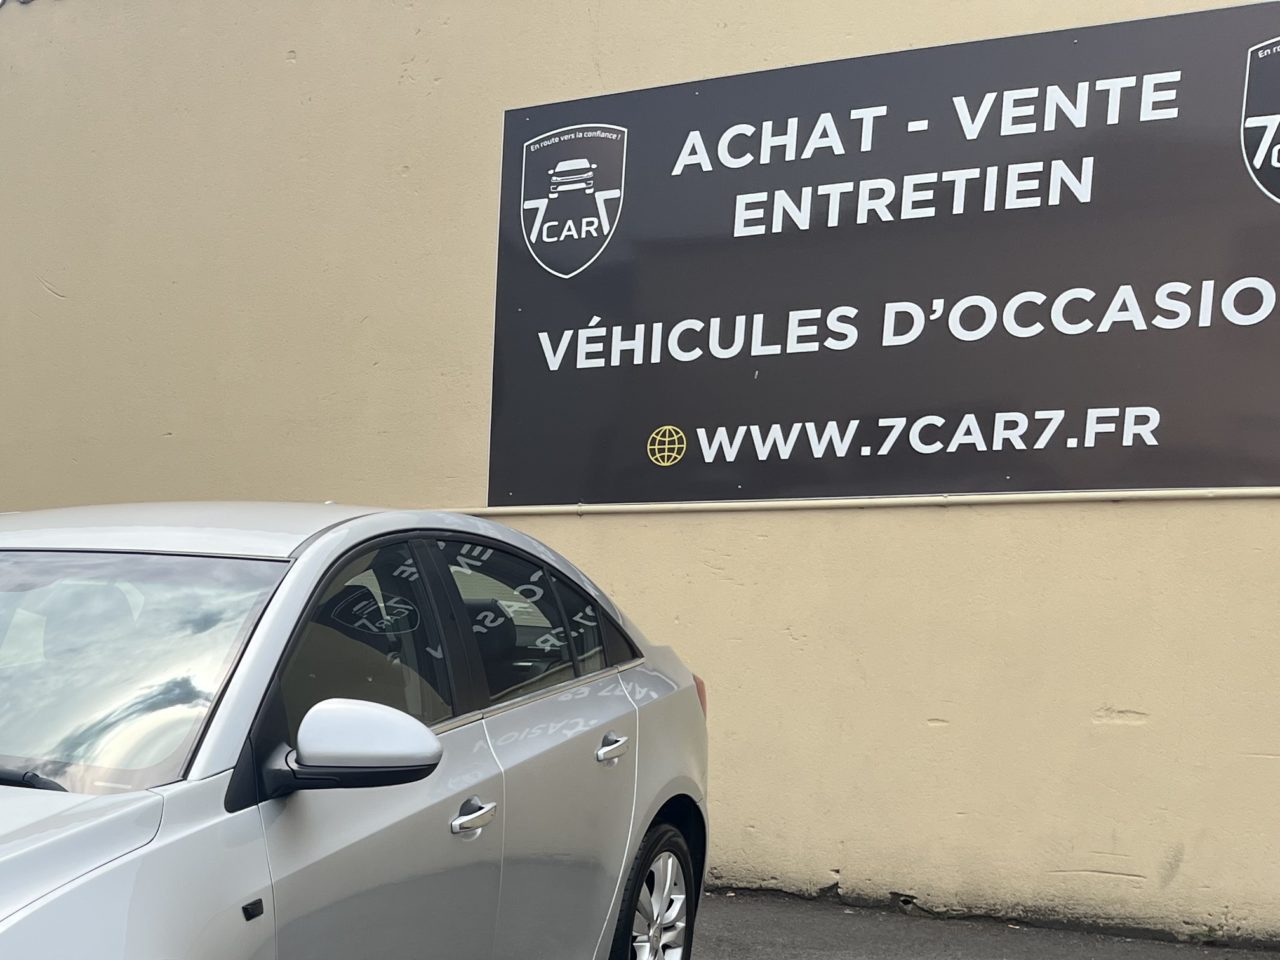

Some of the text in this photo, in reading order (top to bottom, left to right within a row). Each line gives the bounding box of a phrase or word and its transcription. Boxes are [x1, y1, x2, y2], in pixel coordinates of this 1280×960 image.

[530, 143, 540, 152] En
[540, 136, 560, 148] route
[560, 132, 576, 142] vers
[576, 131, 583, 139] la
[584, 131, 617, 140] confiance
[671, 106, 888, 176] ACHAT
[952, 71, 1182, 140] VENTE
[733, 157, 1095, 238] ENTRETIEN
[537, 306, 859, 371] VÉHICULES
[696, 406, 1161, 463] WWW.7CAR7.FR
